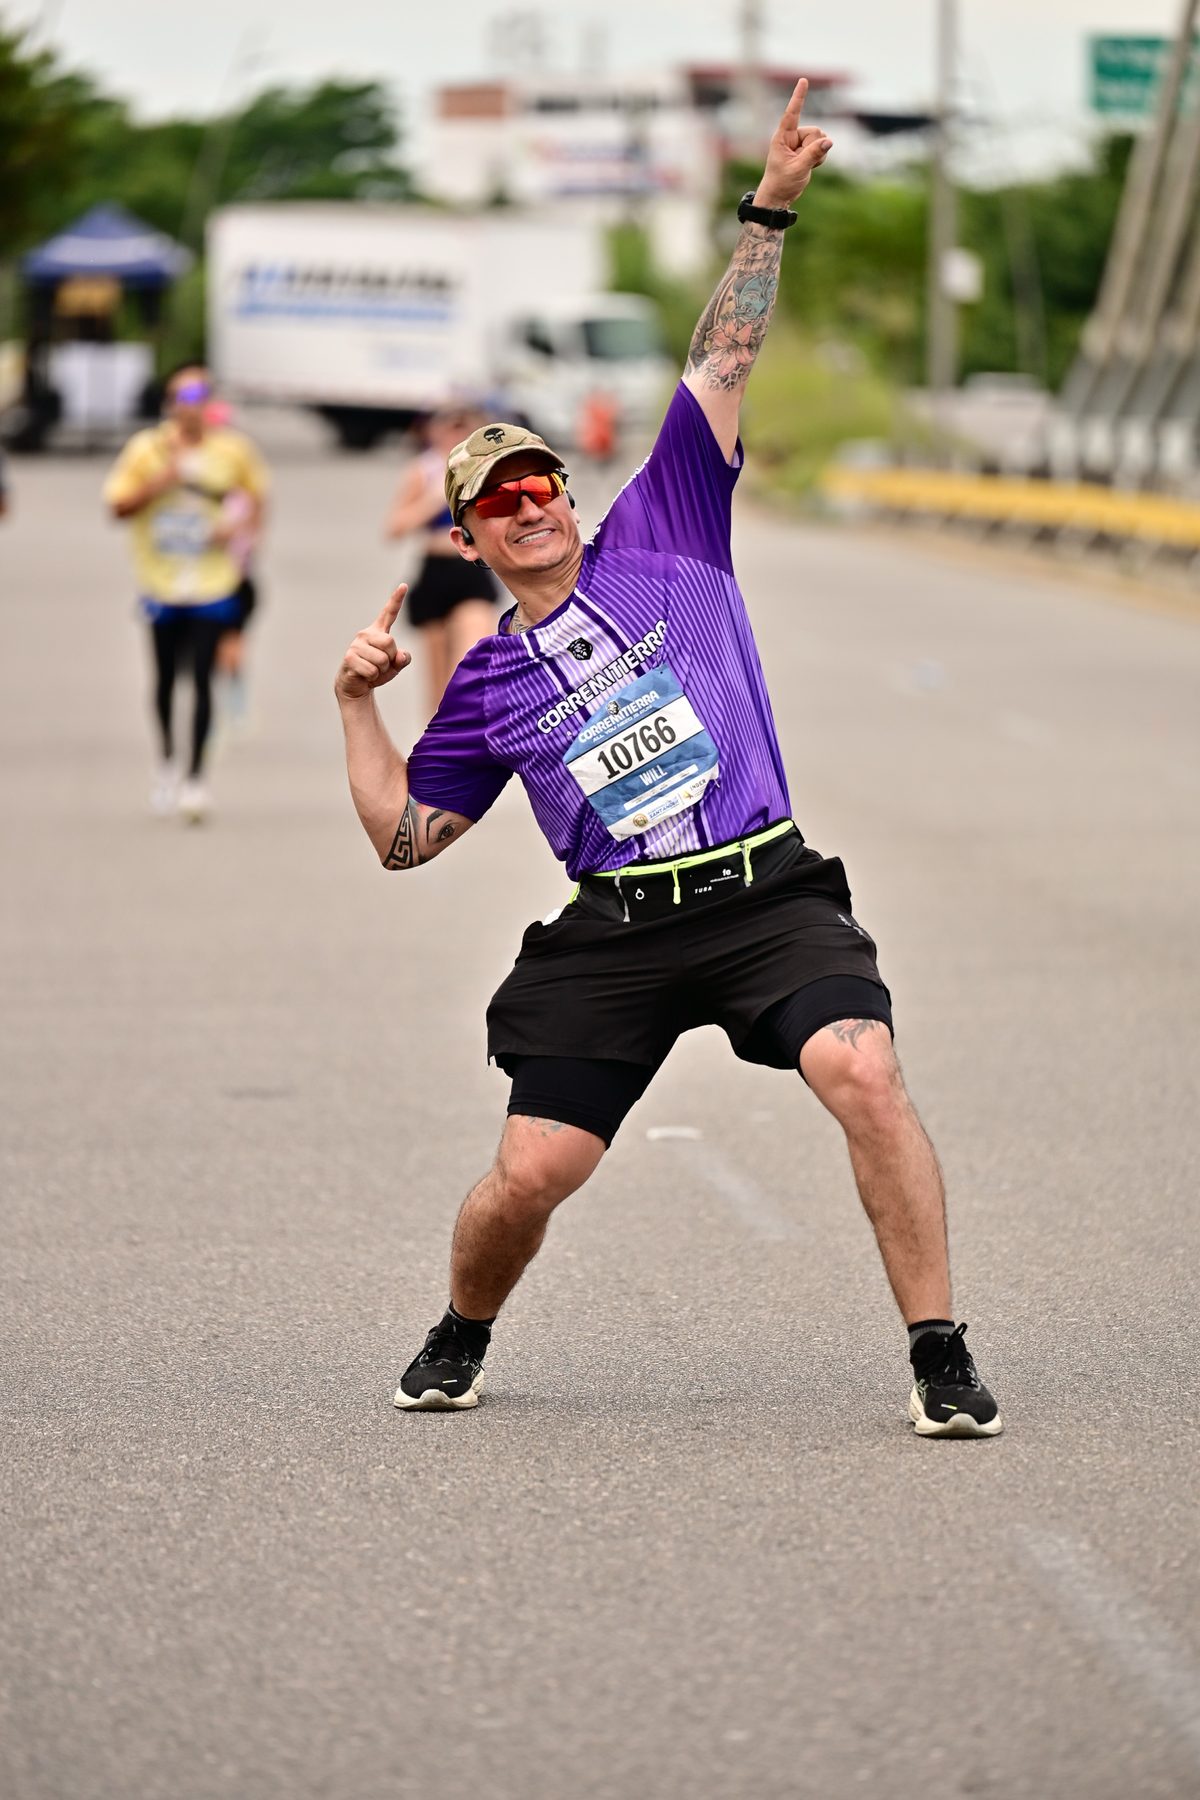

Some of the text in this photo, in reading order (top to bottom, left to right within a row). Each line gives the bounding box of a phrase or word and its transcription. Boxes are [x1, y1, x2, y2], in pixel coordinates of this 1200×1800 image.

[578, 690, 660, 743] CORREMITIERRA
[597, 716, 677, 780] 10766
[639, 764, 668, 786] WILL
